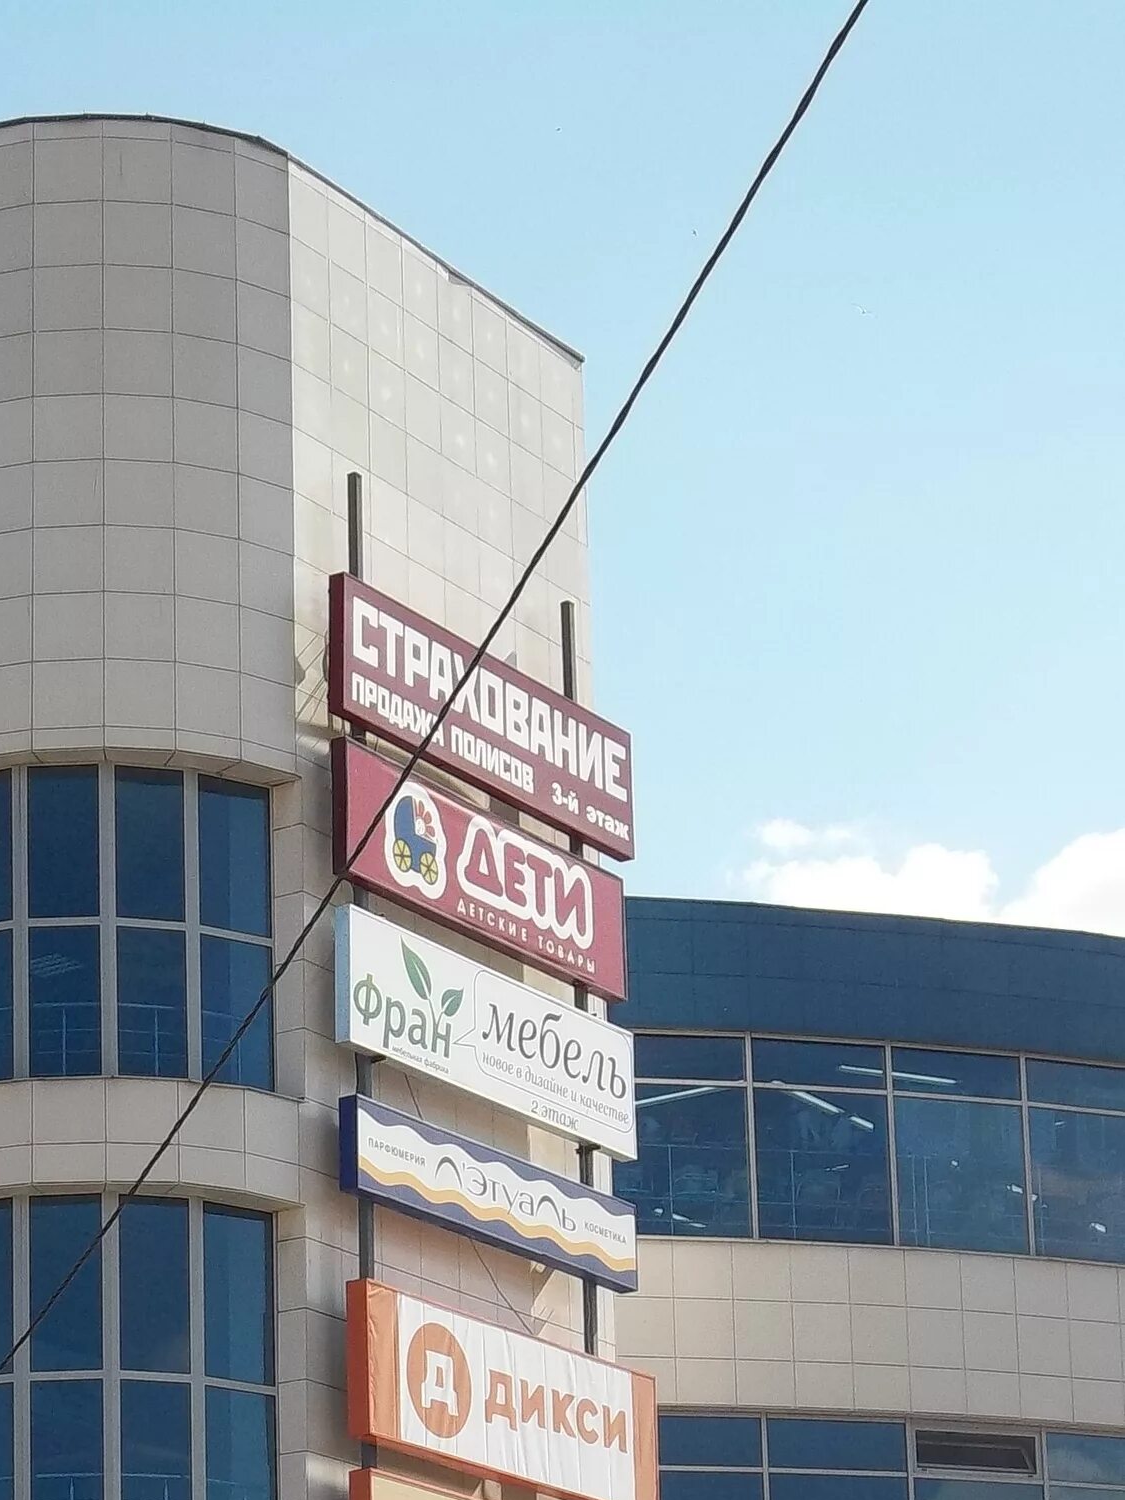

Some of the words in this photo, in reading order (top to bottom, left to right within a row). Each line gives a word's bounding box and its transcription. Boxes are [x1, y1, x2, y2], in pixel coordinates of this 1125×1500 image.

[352, 596, 628, 803] СТРАХОВАНИЕ
[351, 671, 445, 748] ПРОДАЖА
[451, 725, 535, 795] ПОЛИСОВ
[586, 804, 631, 842] этаж
[461, 820, 591, 944] ДЕТИ
[457, 898, 528, 943] ДЕТСКИЕ
[538, 935, 596, 975] ТОВАРЫ
[482, 1004, 628, 1100] мебель
[482, 1052, 513, 1075] новое
[516, 1065, 522, 1079] в
[525, 1065, 568, 1099] дизайне
[570, 1087, 577, 1103] и
[579, 1092, 629, 1125] качестве
[531, 1100, 539, 1115] 2
[541, 1104, 578, 1132] этаж
[368, 1136, 426, 1167] ПАРФЮМЕРИЯ
[583, 1220, 628, 1246] КОСМЕТИКА
